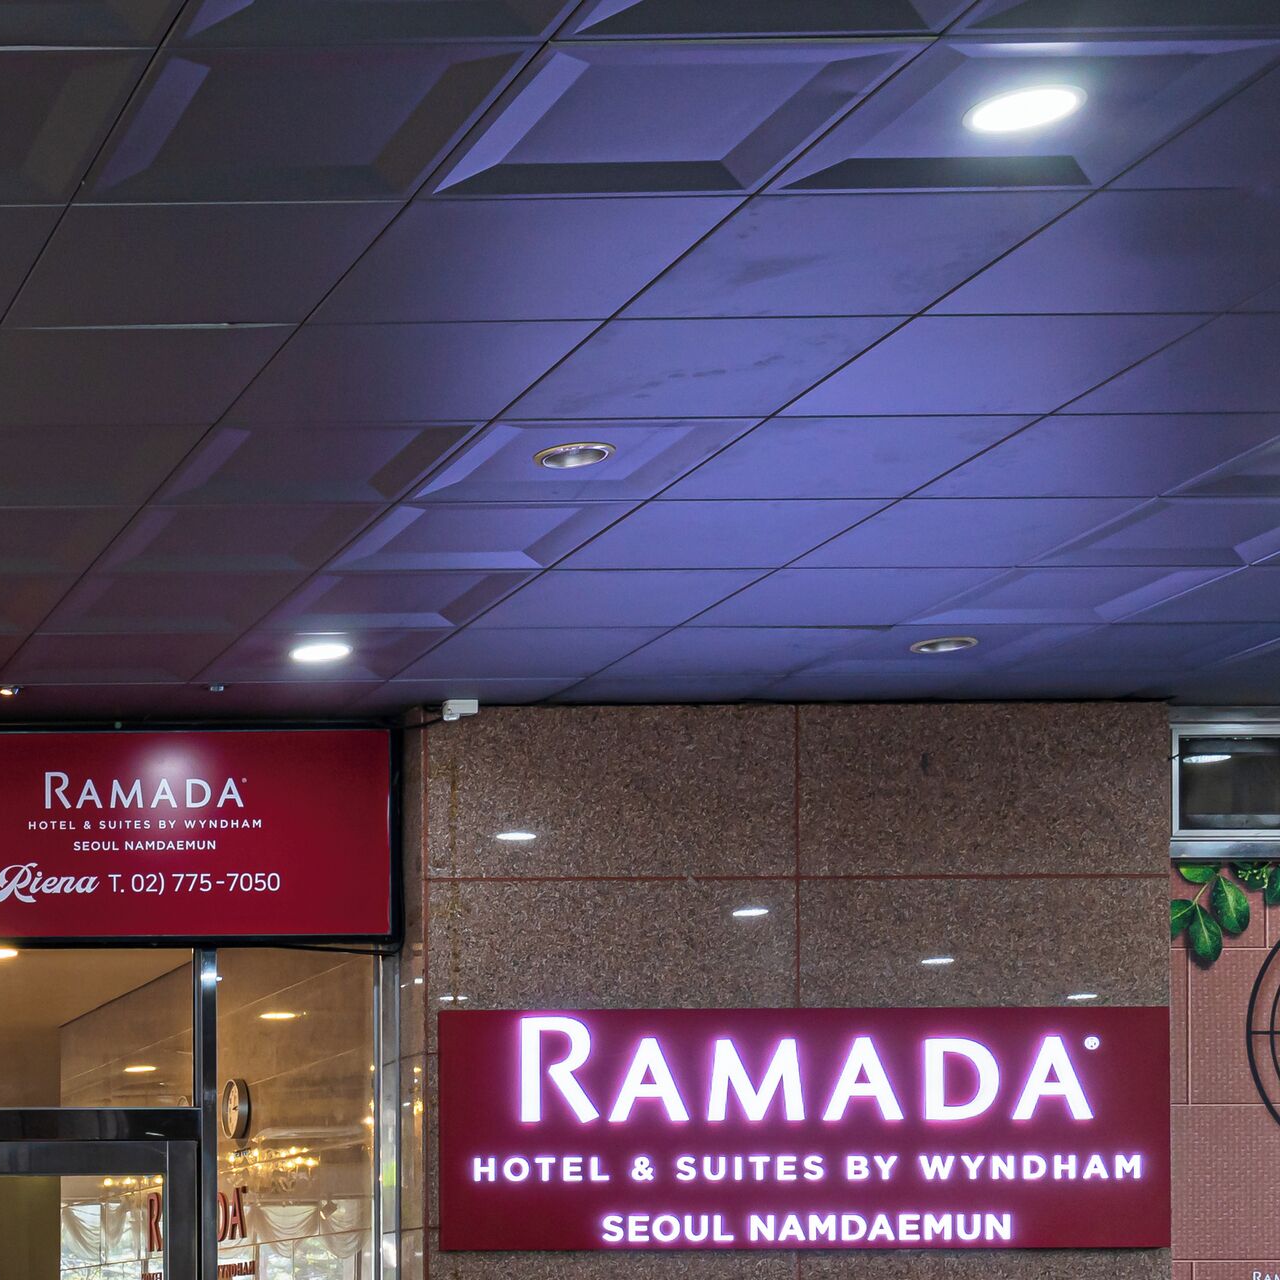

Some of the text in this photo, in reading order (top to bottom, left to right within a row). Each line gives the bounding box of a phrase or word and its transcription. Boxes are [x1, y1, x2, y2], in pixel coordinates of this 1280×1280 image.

[45, 771, 244, 809] RAMADA
[28, 819, 262, 830] HOTEL & SUITES BY WYNDHAM
[73, 840, 217, 851] SEOUL NAMDAEMUN
[108, 874, 125, 893] T.
[131, 873, 164, 895] 02)
[172, 872, 281, 893] 775-7050
[520, 1017, 1095, 1123] RAMADA
[473, 1154, 1142, 1182] HOTEL & SUITES BY WYNDHAM
[602, 1214, 1012, 1242] SEOUL NAMDAEMUN
